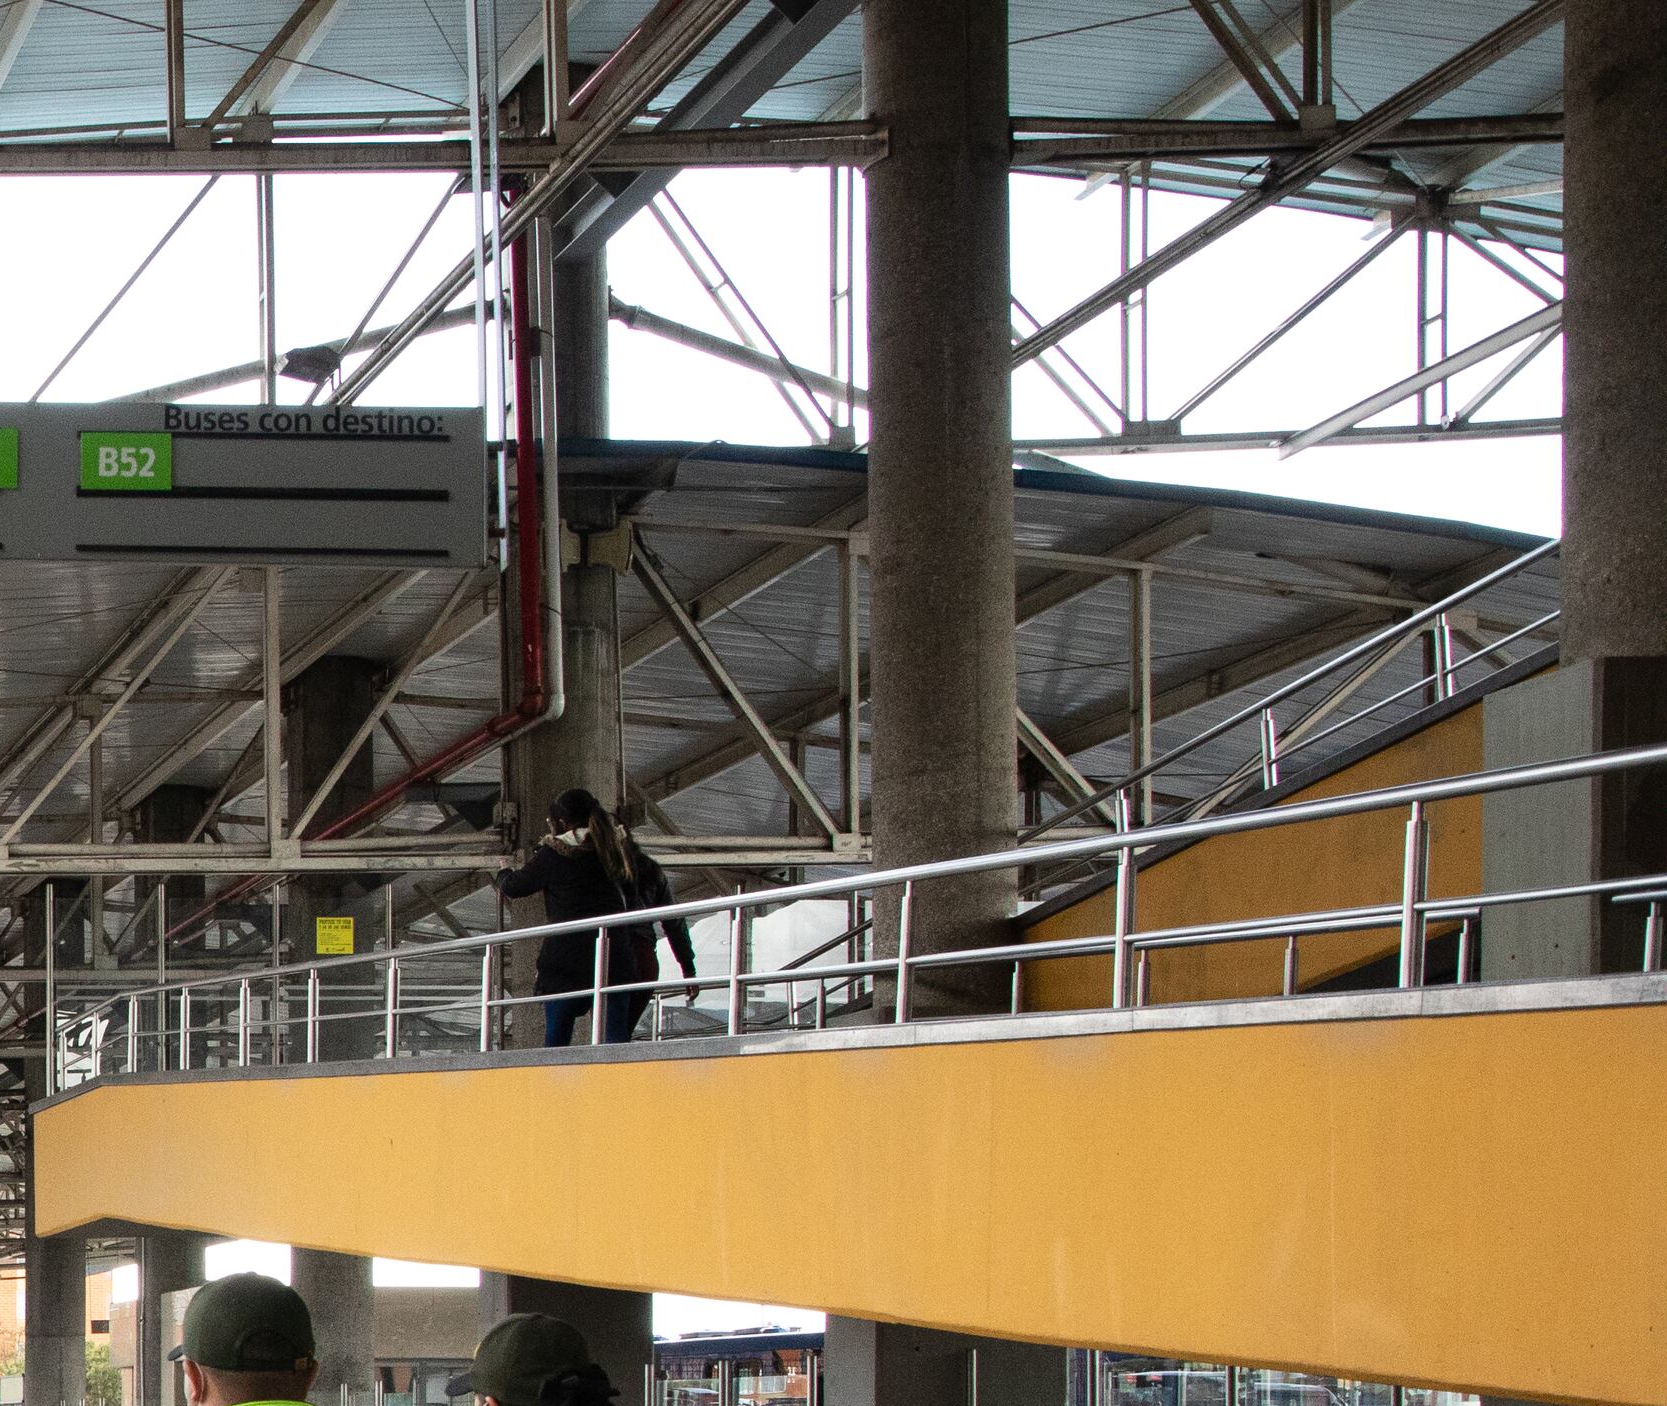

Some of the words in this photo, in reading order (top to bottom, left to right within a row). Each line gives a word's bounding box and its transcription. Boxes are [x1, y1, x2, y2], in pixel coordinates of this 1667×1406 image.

[165, 407, 249, 433] Buses
[259, 412, 312, 434] con
[321, 408, 444, 436] destino:
[97, 446, 156, 478] B52
